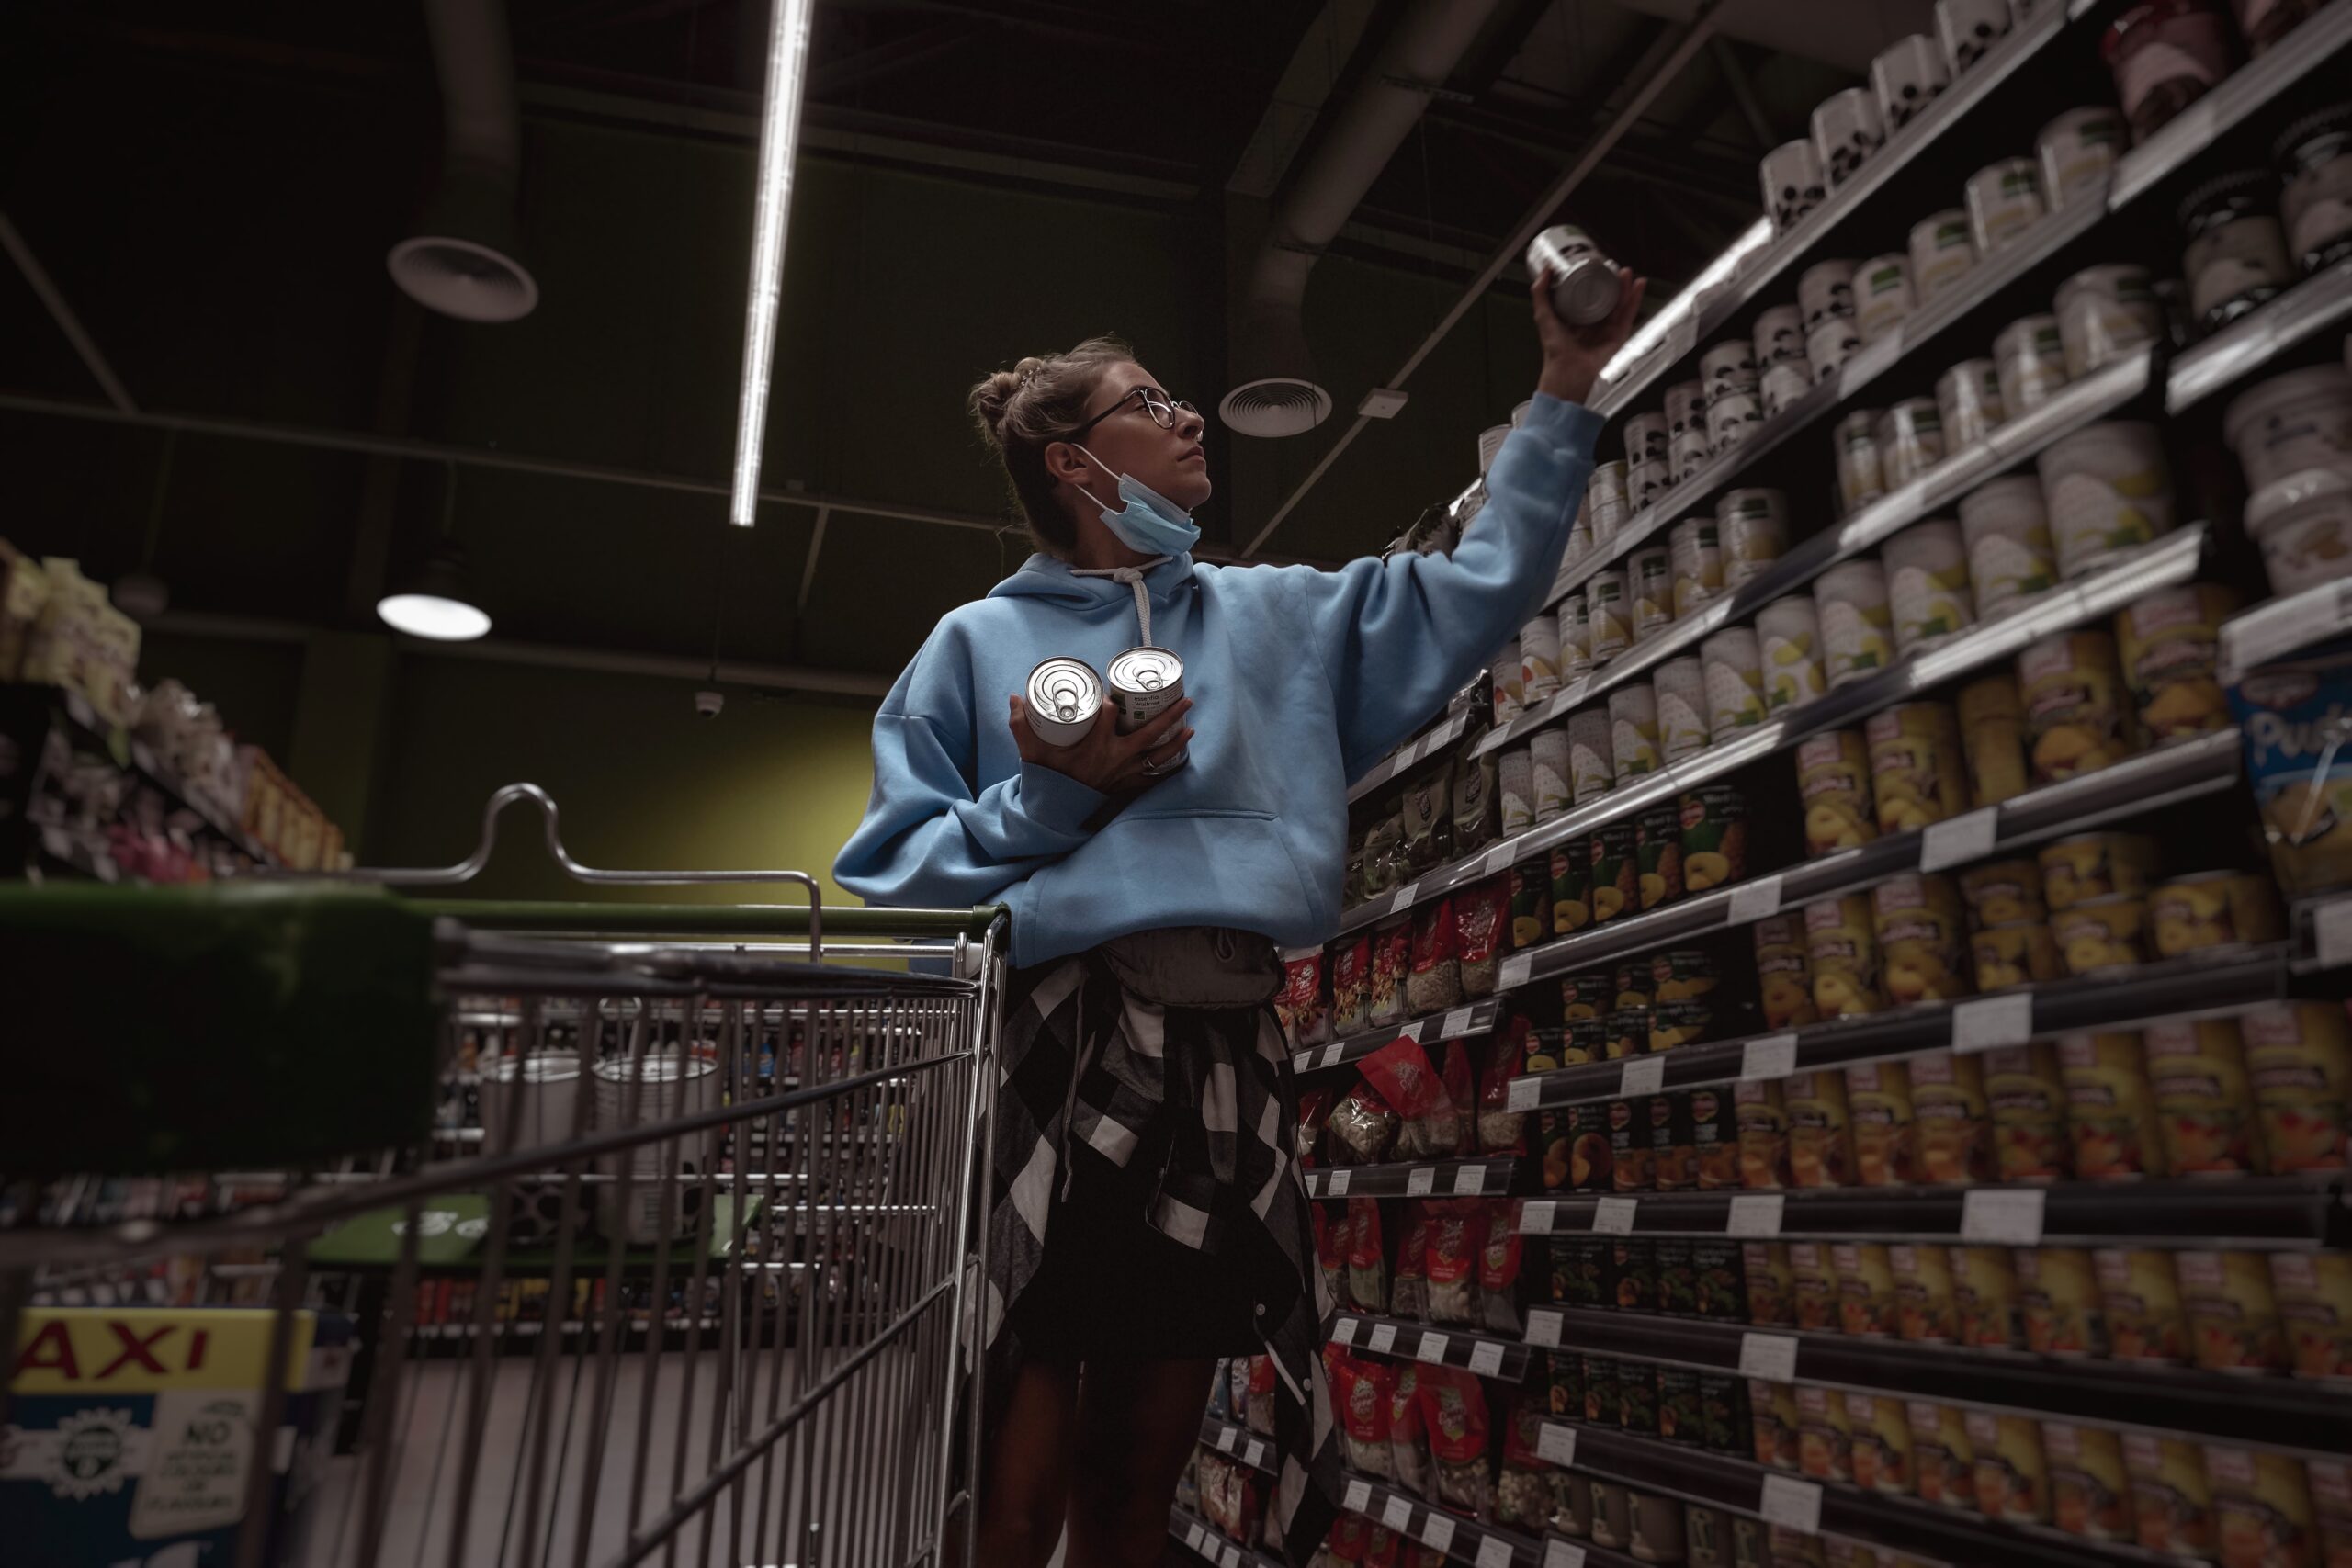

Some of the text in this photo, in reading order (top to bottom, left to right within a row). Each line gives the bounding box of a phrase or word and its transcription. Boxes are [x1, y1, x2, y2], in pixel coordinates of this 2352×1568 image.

[1134, 694, 1160, 702] essential
[2245, 702, 2352, 769] Pud
[186, 1421, 231, 1444] NO
